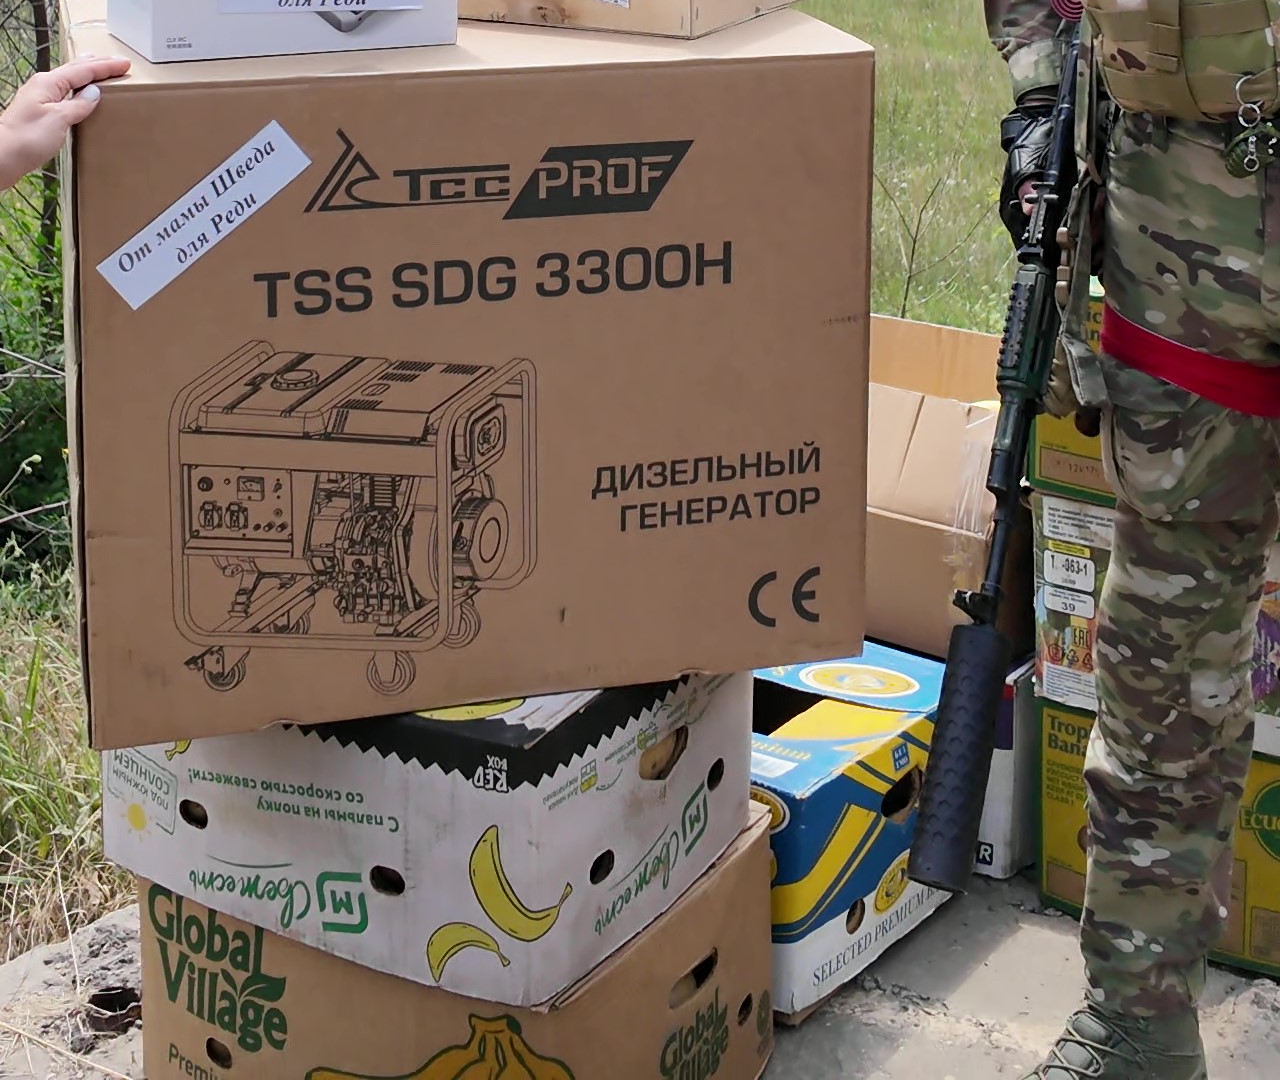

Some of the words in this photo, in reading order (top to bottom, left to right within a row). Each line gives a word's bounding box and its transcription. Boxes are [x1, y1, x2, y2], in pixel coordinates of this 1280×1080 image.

[537, 154, 675, 201] PROF
[118, 241, 153, 273] От
[155, 194, 210, 247] мамы
[209, 140, 276, 199] Шведа
[176, 232, 210, 264] для
[209, 192, 258, 236] Реди
[253, 266, 373, 318] TSS
[391, 255, 518, 309] SDG
[534, 240, 733, 299] 3300H
[591, 441, 821, 500] ДИЗЕЛЬНЫЙ
[619, 486, 821, 532] ГЕНЕРАТОР
[1061, 602, 1077, 613] 39
[1048, 732, 1088, 757] Bana
[113, 750, 171, 796] СОЛНЦЕМ
[187, 767, 257, 791] свежести!
[261, 780, 343, 802] скоростью
[473, 765, 508, 793] RED
[256, 794, 301, 817] полку
[302, 806, 321, 818] на
[324, 809, 384, 827] пальмы
[345, 791, 364, 804] со
[387, 815, 400, 833] С
[188, 868, 312, 930] Свежесть
[594, 830, 680, 936] Свежесть
[148, 882, 269, 975] Global
[812, 931, 873, 987] SELECTED
[874, 888, 924, 943] PREMIUM
[156, 935, 288, 1053] Village
[168, 1042, 220, 1080] Premi
